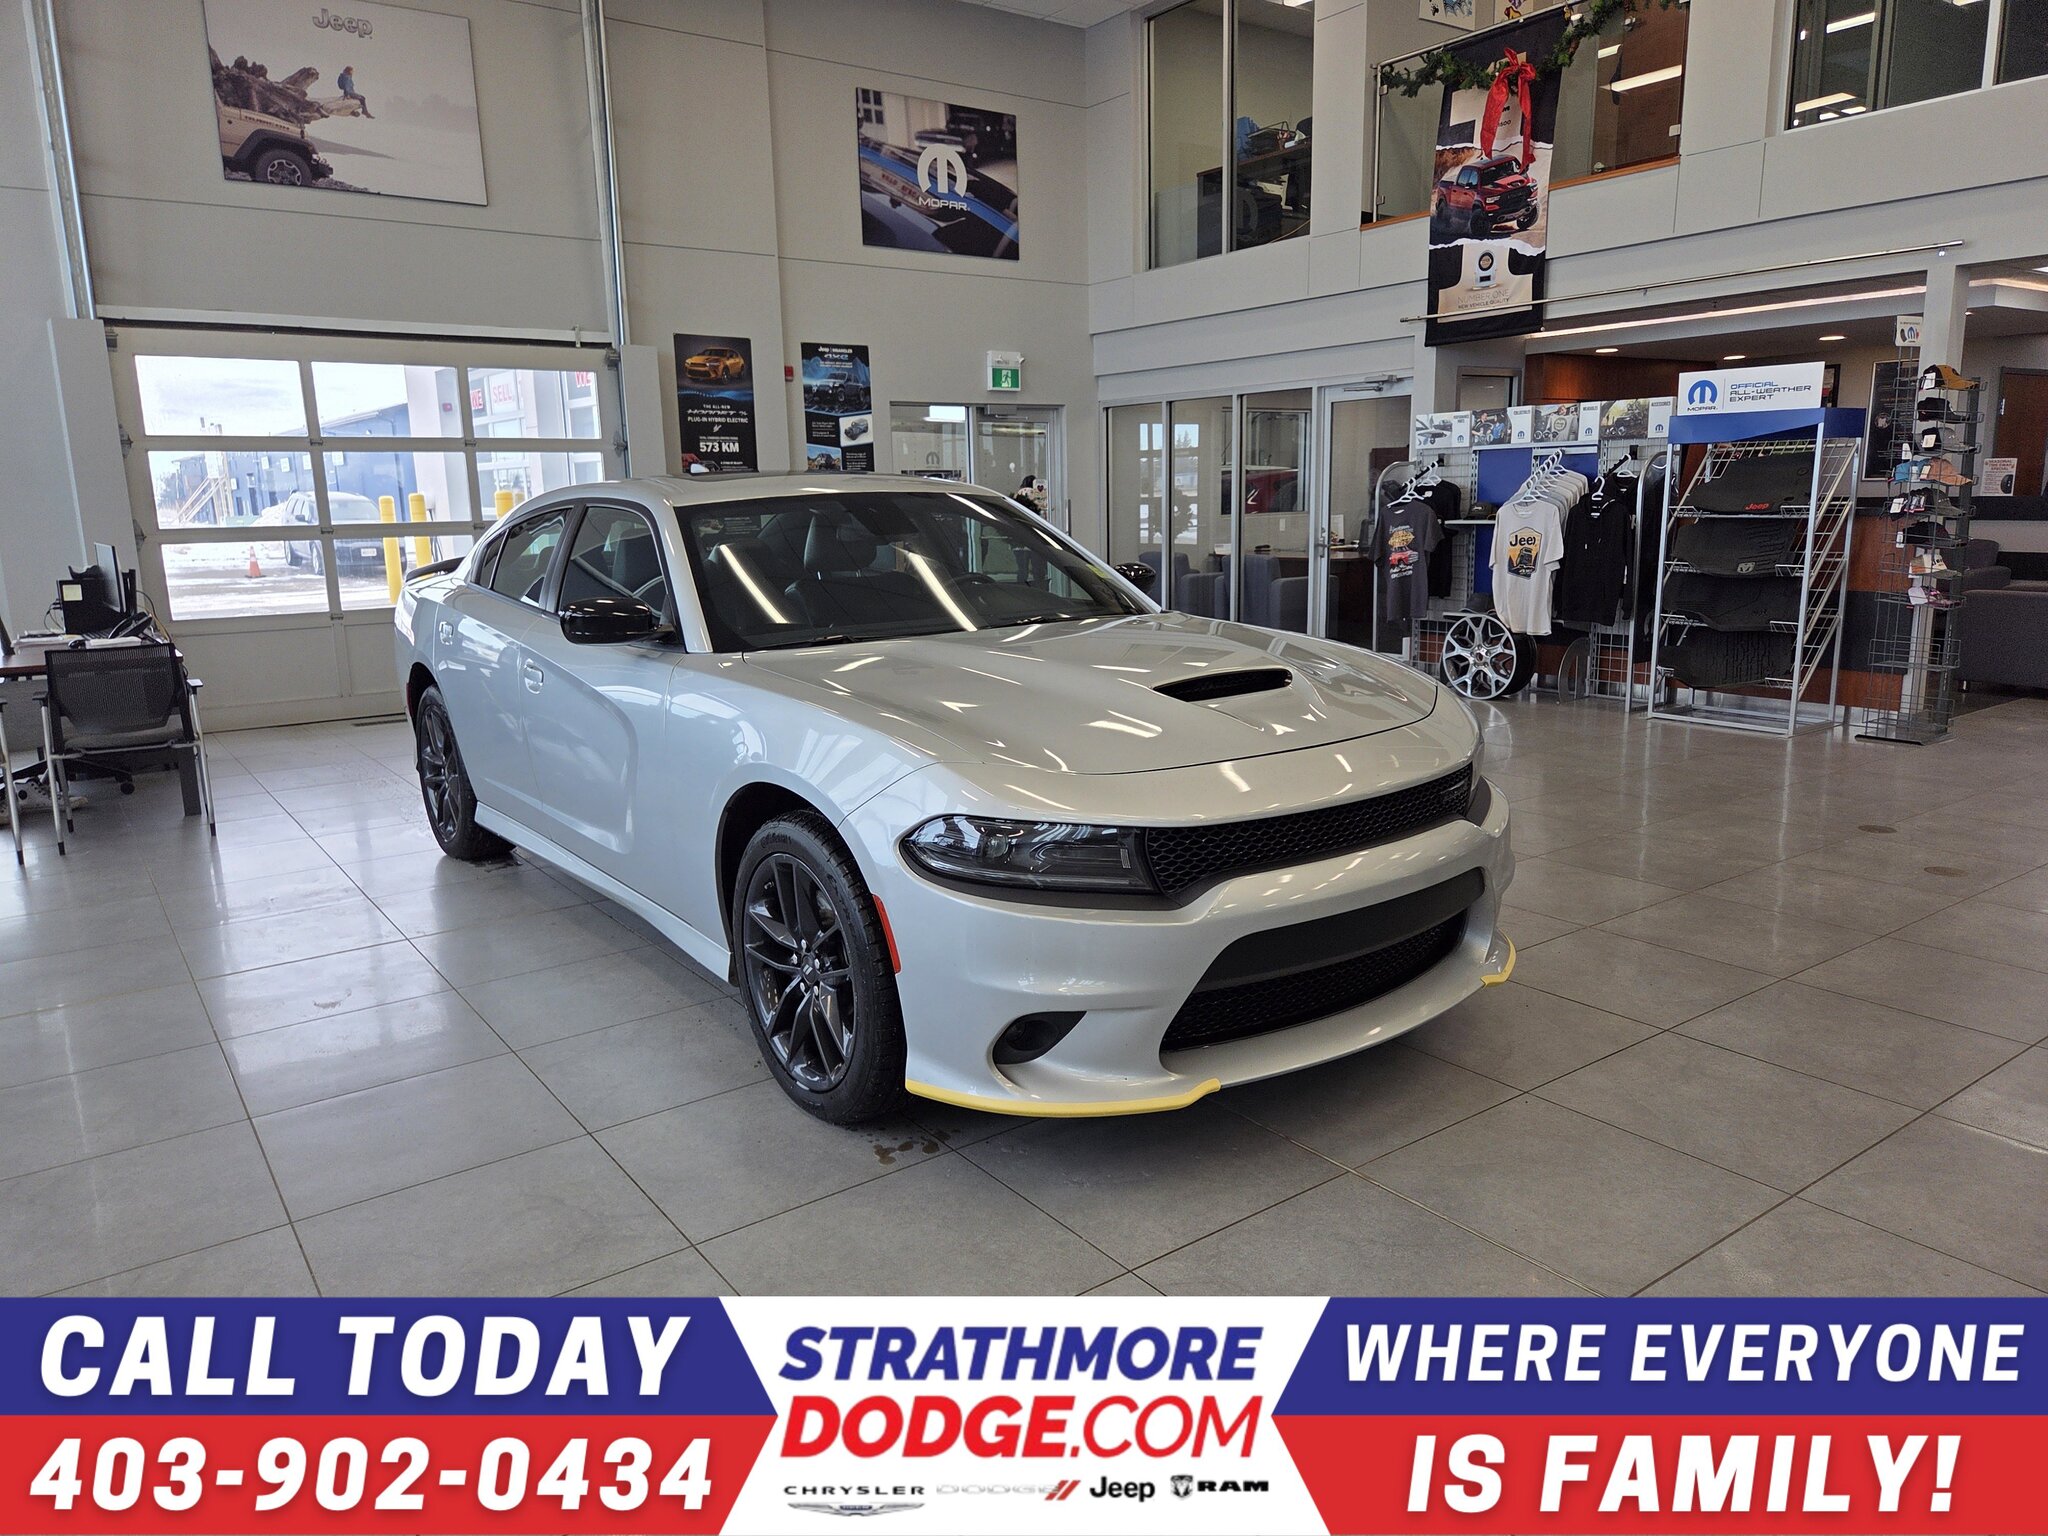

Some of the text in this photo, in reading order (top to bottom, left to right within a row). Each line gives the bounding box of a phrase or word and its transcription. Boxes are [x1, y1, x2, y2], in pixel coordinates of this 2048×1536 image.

[312, 8, 373, 38] Jeep
[918, 196, 969, 212] MOPAR
[1729, 385, 1812, 396] ALL-WEATHER
[1730, 380, 1778, 390] OFFICIAL
[492, 384, 513, 403] SELL
[1729, 394, 1774, 402] EXPERT
[700, 442, 740, 453] 573 KM
